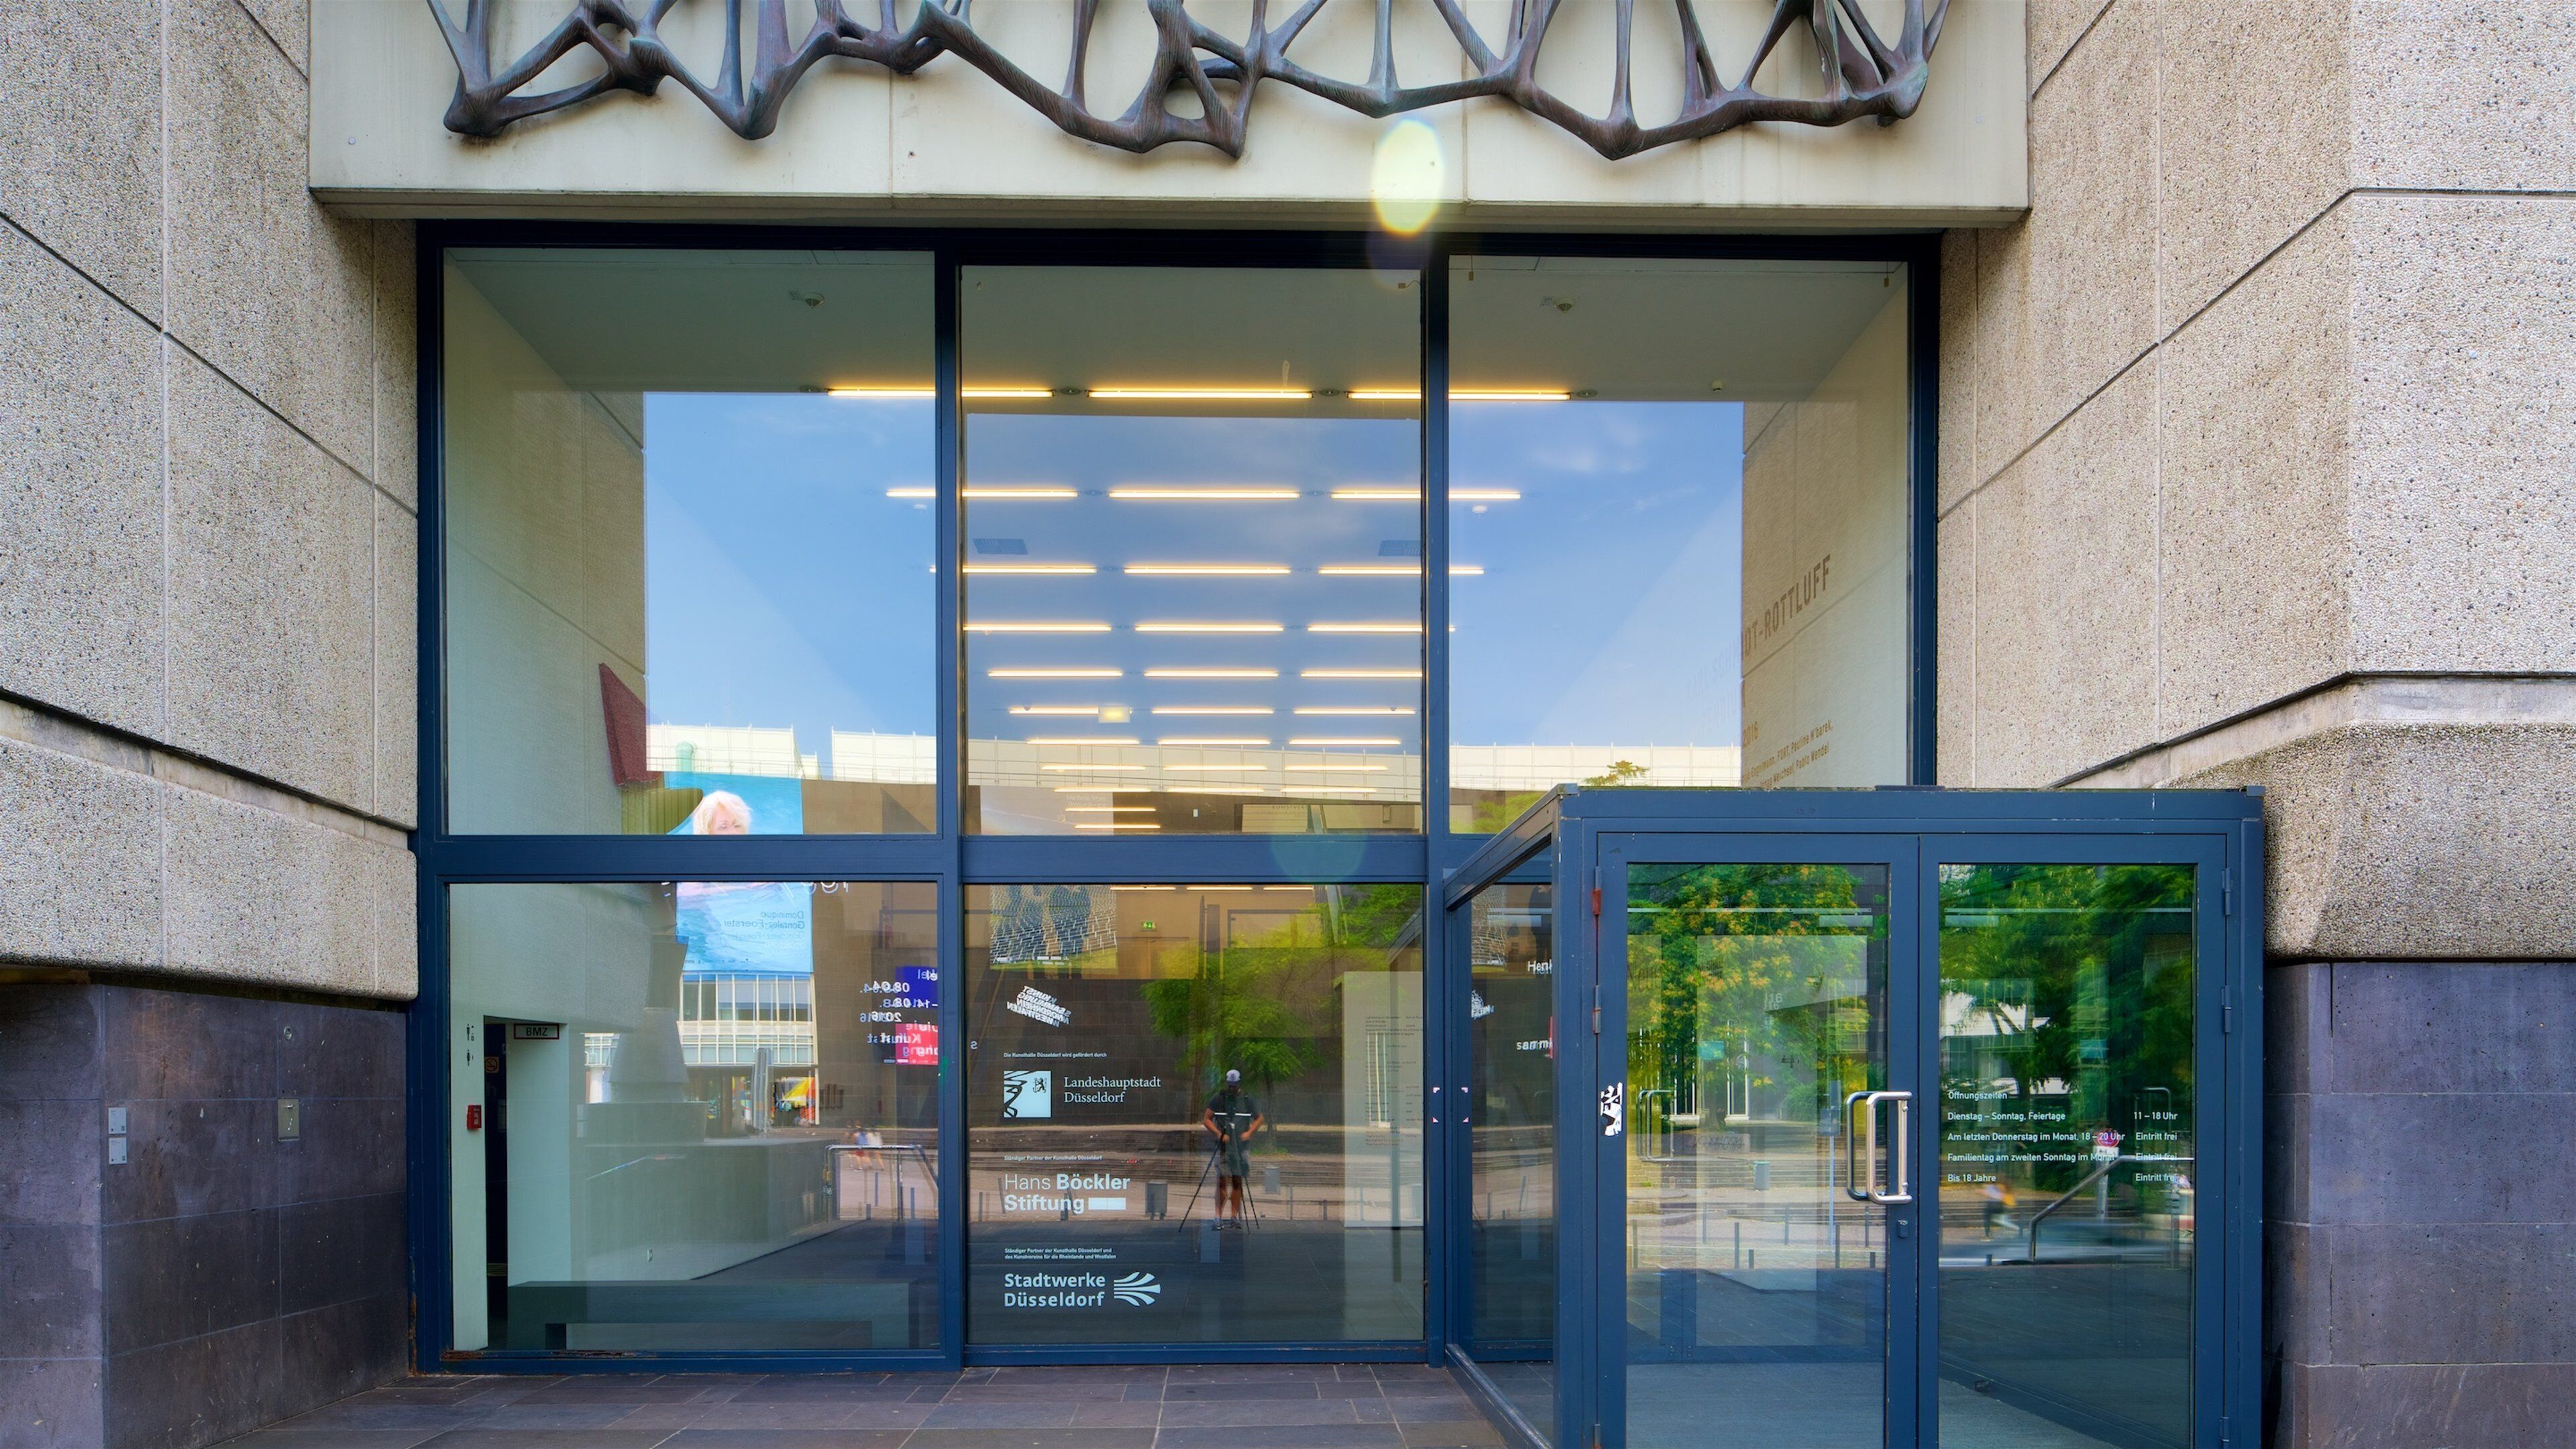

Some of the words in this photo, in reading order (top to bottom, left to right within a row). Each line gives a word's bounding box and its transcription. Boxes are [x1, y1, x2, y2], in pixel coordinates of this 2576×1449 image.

[526, 1027, 547, 1036] BMZ
[1065, 1076, 1161, 1090] Landeshauptstadt
[1065, 1091, 1126, 1103] Düsseldorf
[1947, 1090, 2008, 1101] Öffnungszeiten
[1948, 1112, 1982, 1122] Dienstag
[2029, 1112, 2065, 1122] Feiertage
[2152, 1112, 2161, 1120] 18
[2163, 1112, 2178, 1120] Uhr
[1964, 1132, 1991, 1140] letzten
[1992, 1132, 2037, 1144] Donnerstag
[2040, 1132, 2050, 1140] im
[2082, 1132, 2090, 1140] 18
[2098, 1132, 2109, 1141] 20
[2110, 1132, 2125, 1141] Uhr
[2164, 1132, 2177, 1140] frei
[1948, 1153, 1994, 1163] Familientag
[2010, 1153, 2041, 1161] zweiten
[2043, 1153, 2076, 1163] Sonntag
[2090, 1152, 2116, 1163] Monat
[2135, 1152, 2163, 1161] Eintritt
[1004, 1174, 1051, 1190] Hans
[1056, 1173, 1130, 1191] Böckler
[1948, 1174, 1960, 1182] Bis
[1004, 1194, 1084, 1214] Stiftung
[1004, 1273, 1106, 1288] Stadtwerke
[1004, 1291, 1104, 1307] Düsseldorf
